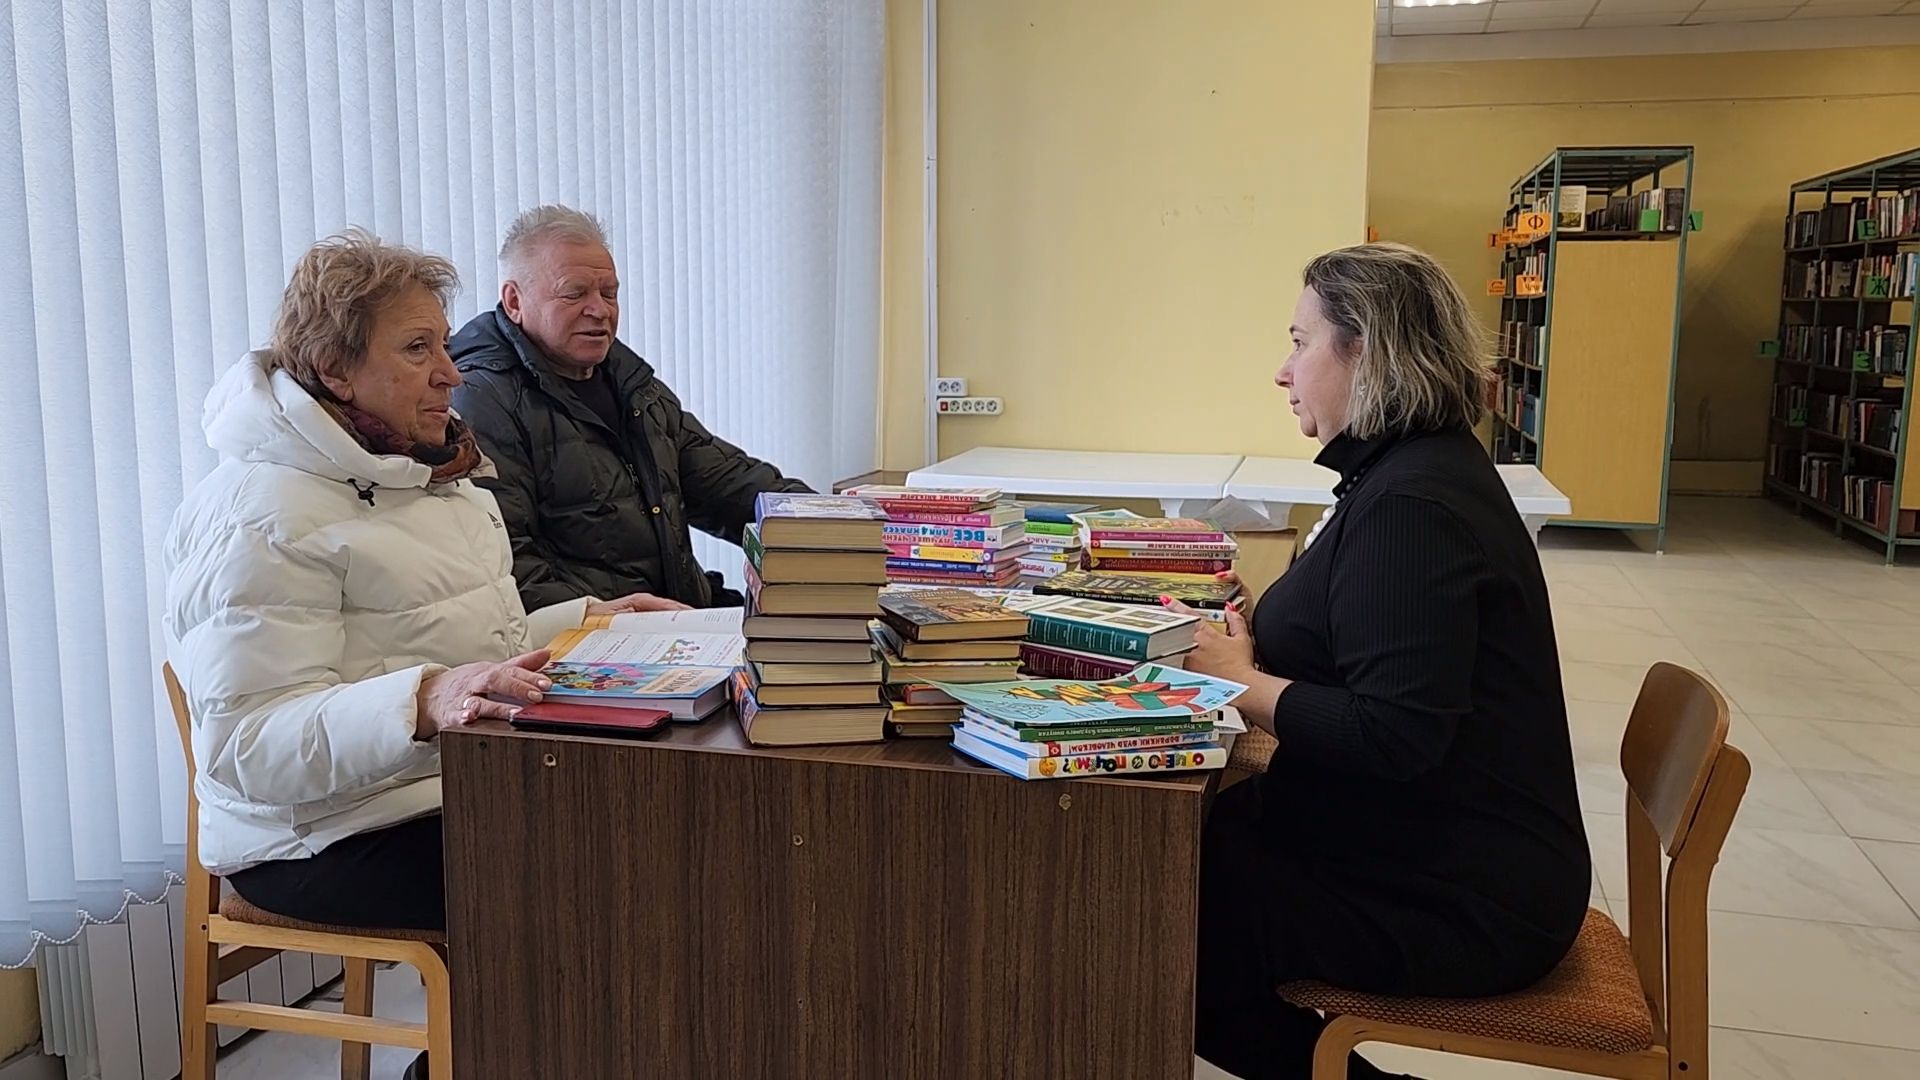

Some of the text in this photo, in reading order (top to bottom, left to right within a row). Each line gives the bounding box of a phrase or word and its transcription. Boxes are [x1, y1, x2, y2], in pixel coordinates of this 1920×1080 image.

[1528, 214, 1544, 230] Ф
[1864, 219, 1877, 237] Е
[1871, 276, 1888, 296] Ж
[1856, 352, 1870, 369] З
[921, 526, 929, 537] 4
[953, 529, 985, 545] ВСЁ
[1068, 741, 1117, 755] ЧЕЛОВЕКОМ!
[1117, 739, 1138, 749] БУДЬ
[1062, 755, 1127, 775] ПОЧЕМУ?
[1148, 751, 1206, 769] ОТЧЕГО
